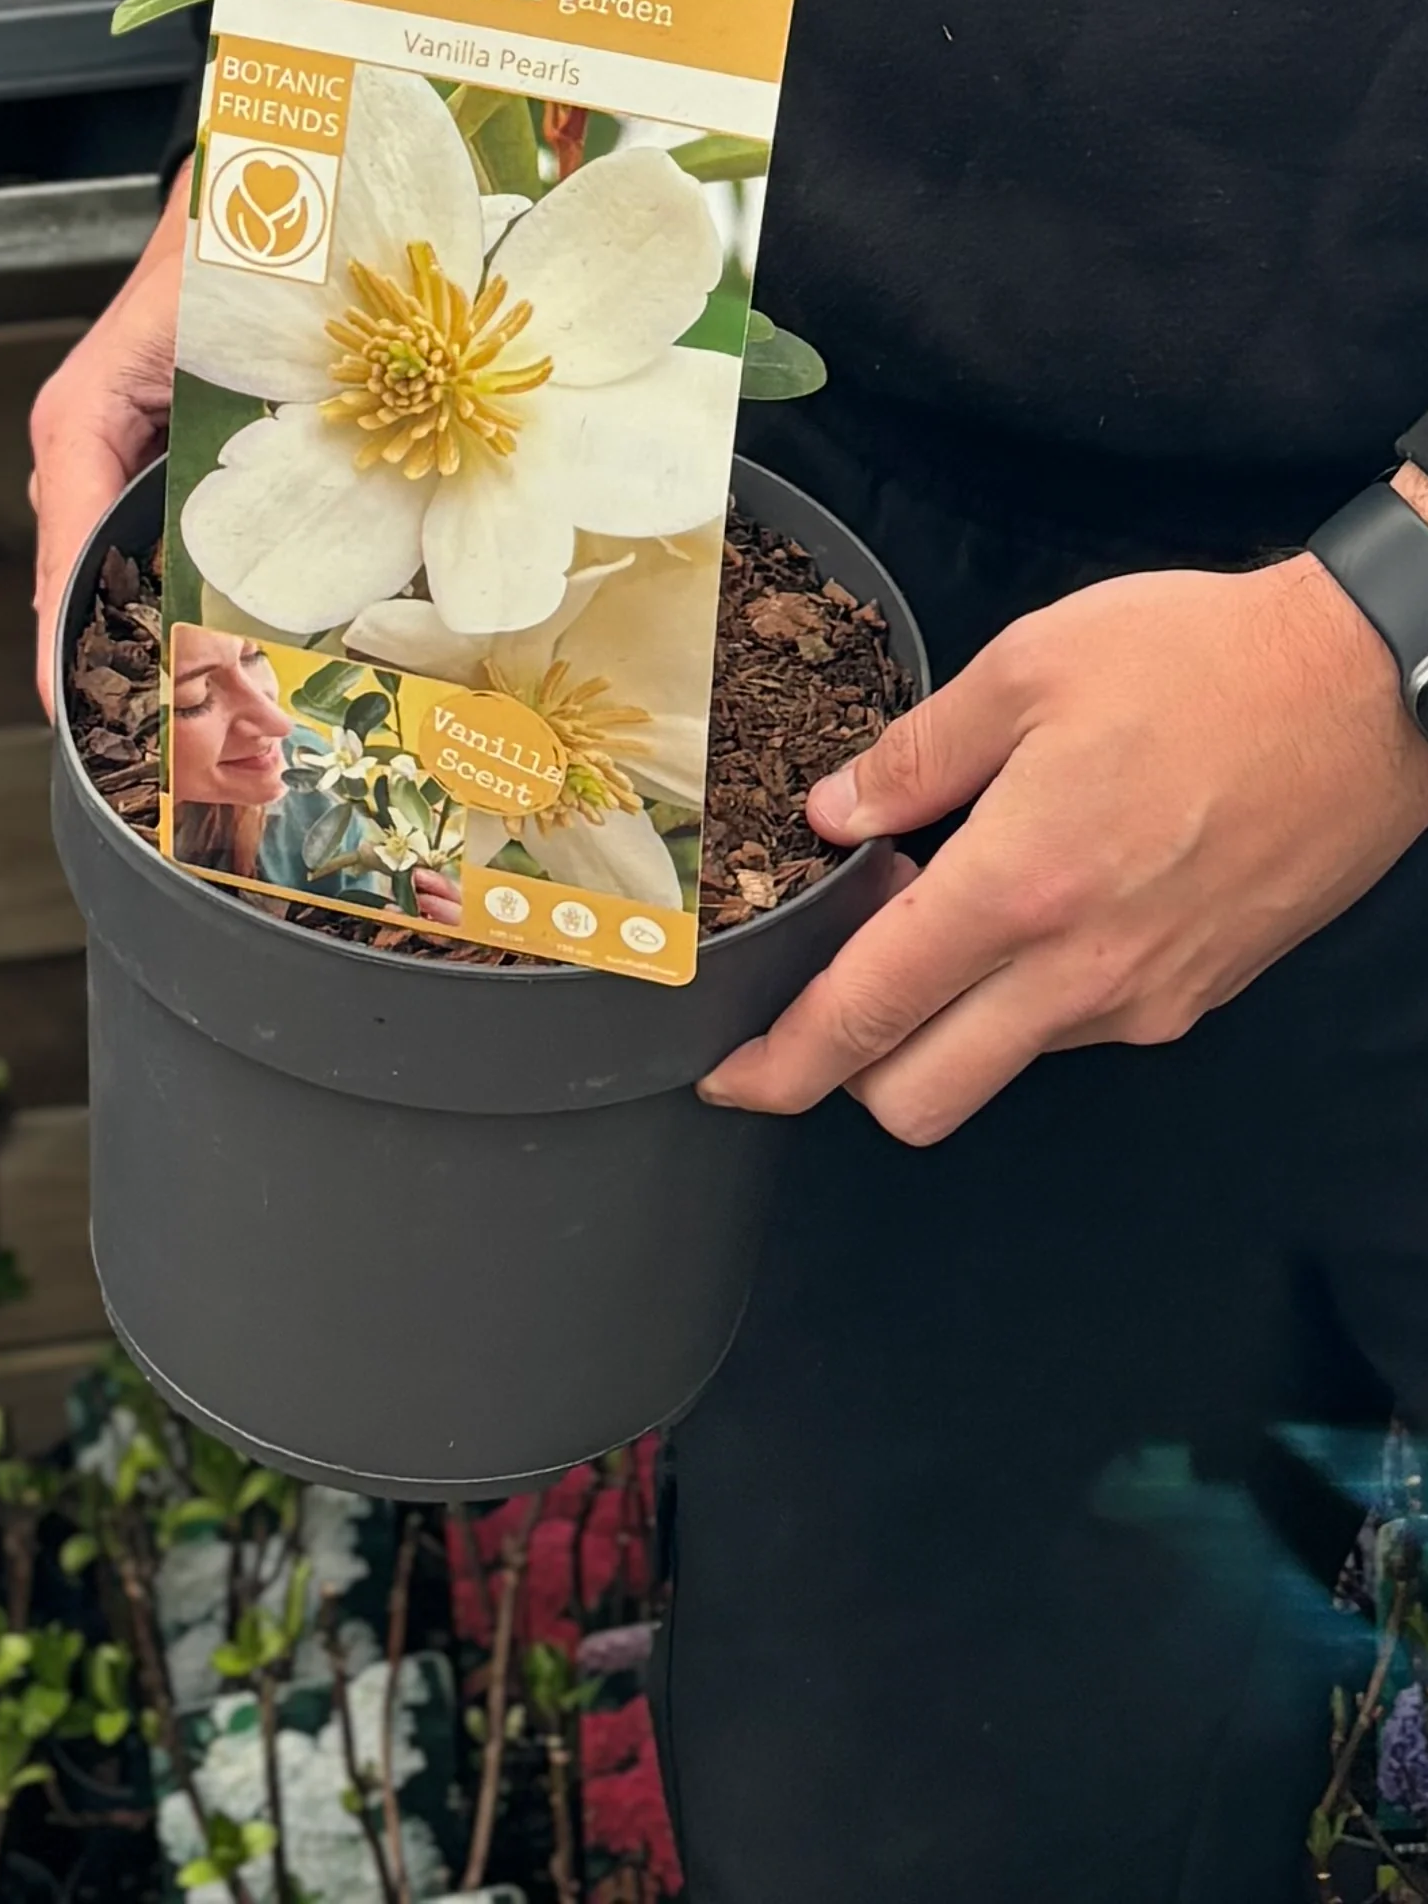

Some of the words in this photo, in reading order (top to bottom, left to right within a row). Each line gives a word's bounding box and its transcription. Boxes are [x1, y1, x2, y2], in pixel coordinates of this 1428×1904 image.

[222, 55, 346, 102] BOTANIC
[402, 29, 491, 69] Vanilla
[499, 48, 581, 87] Pearls
[217, 91, 341, 138] FRIENDS
[434, 705, 564, 787] Vanilla
[436, 747, 534, 807] Scent
